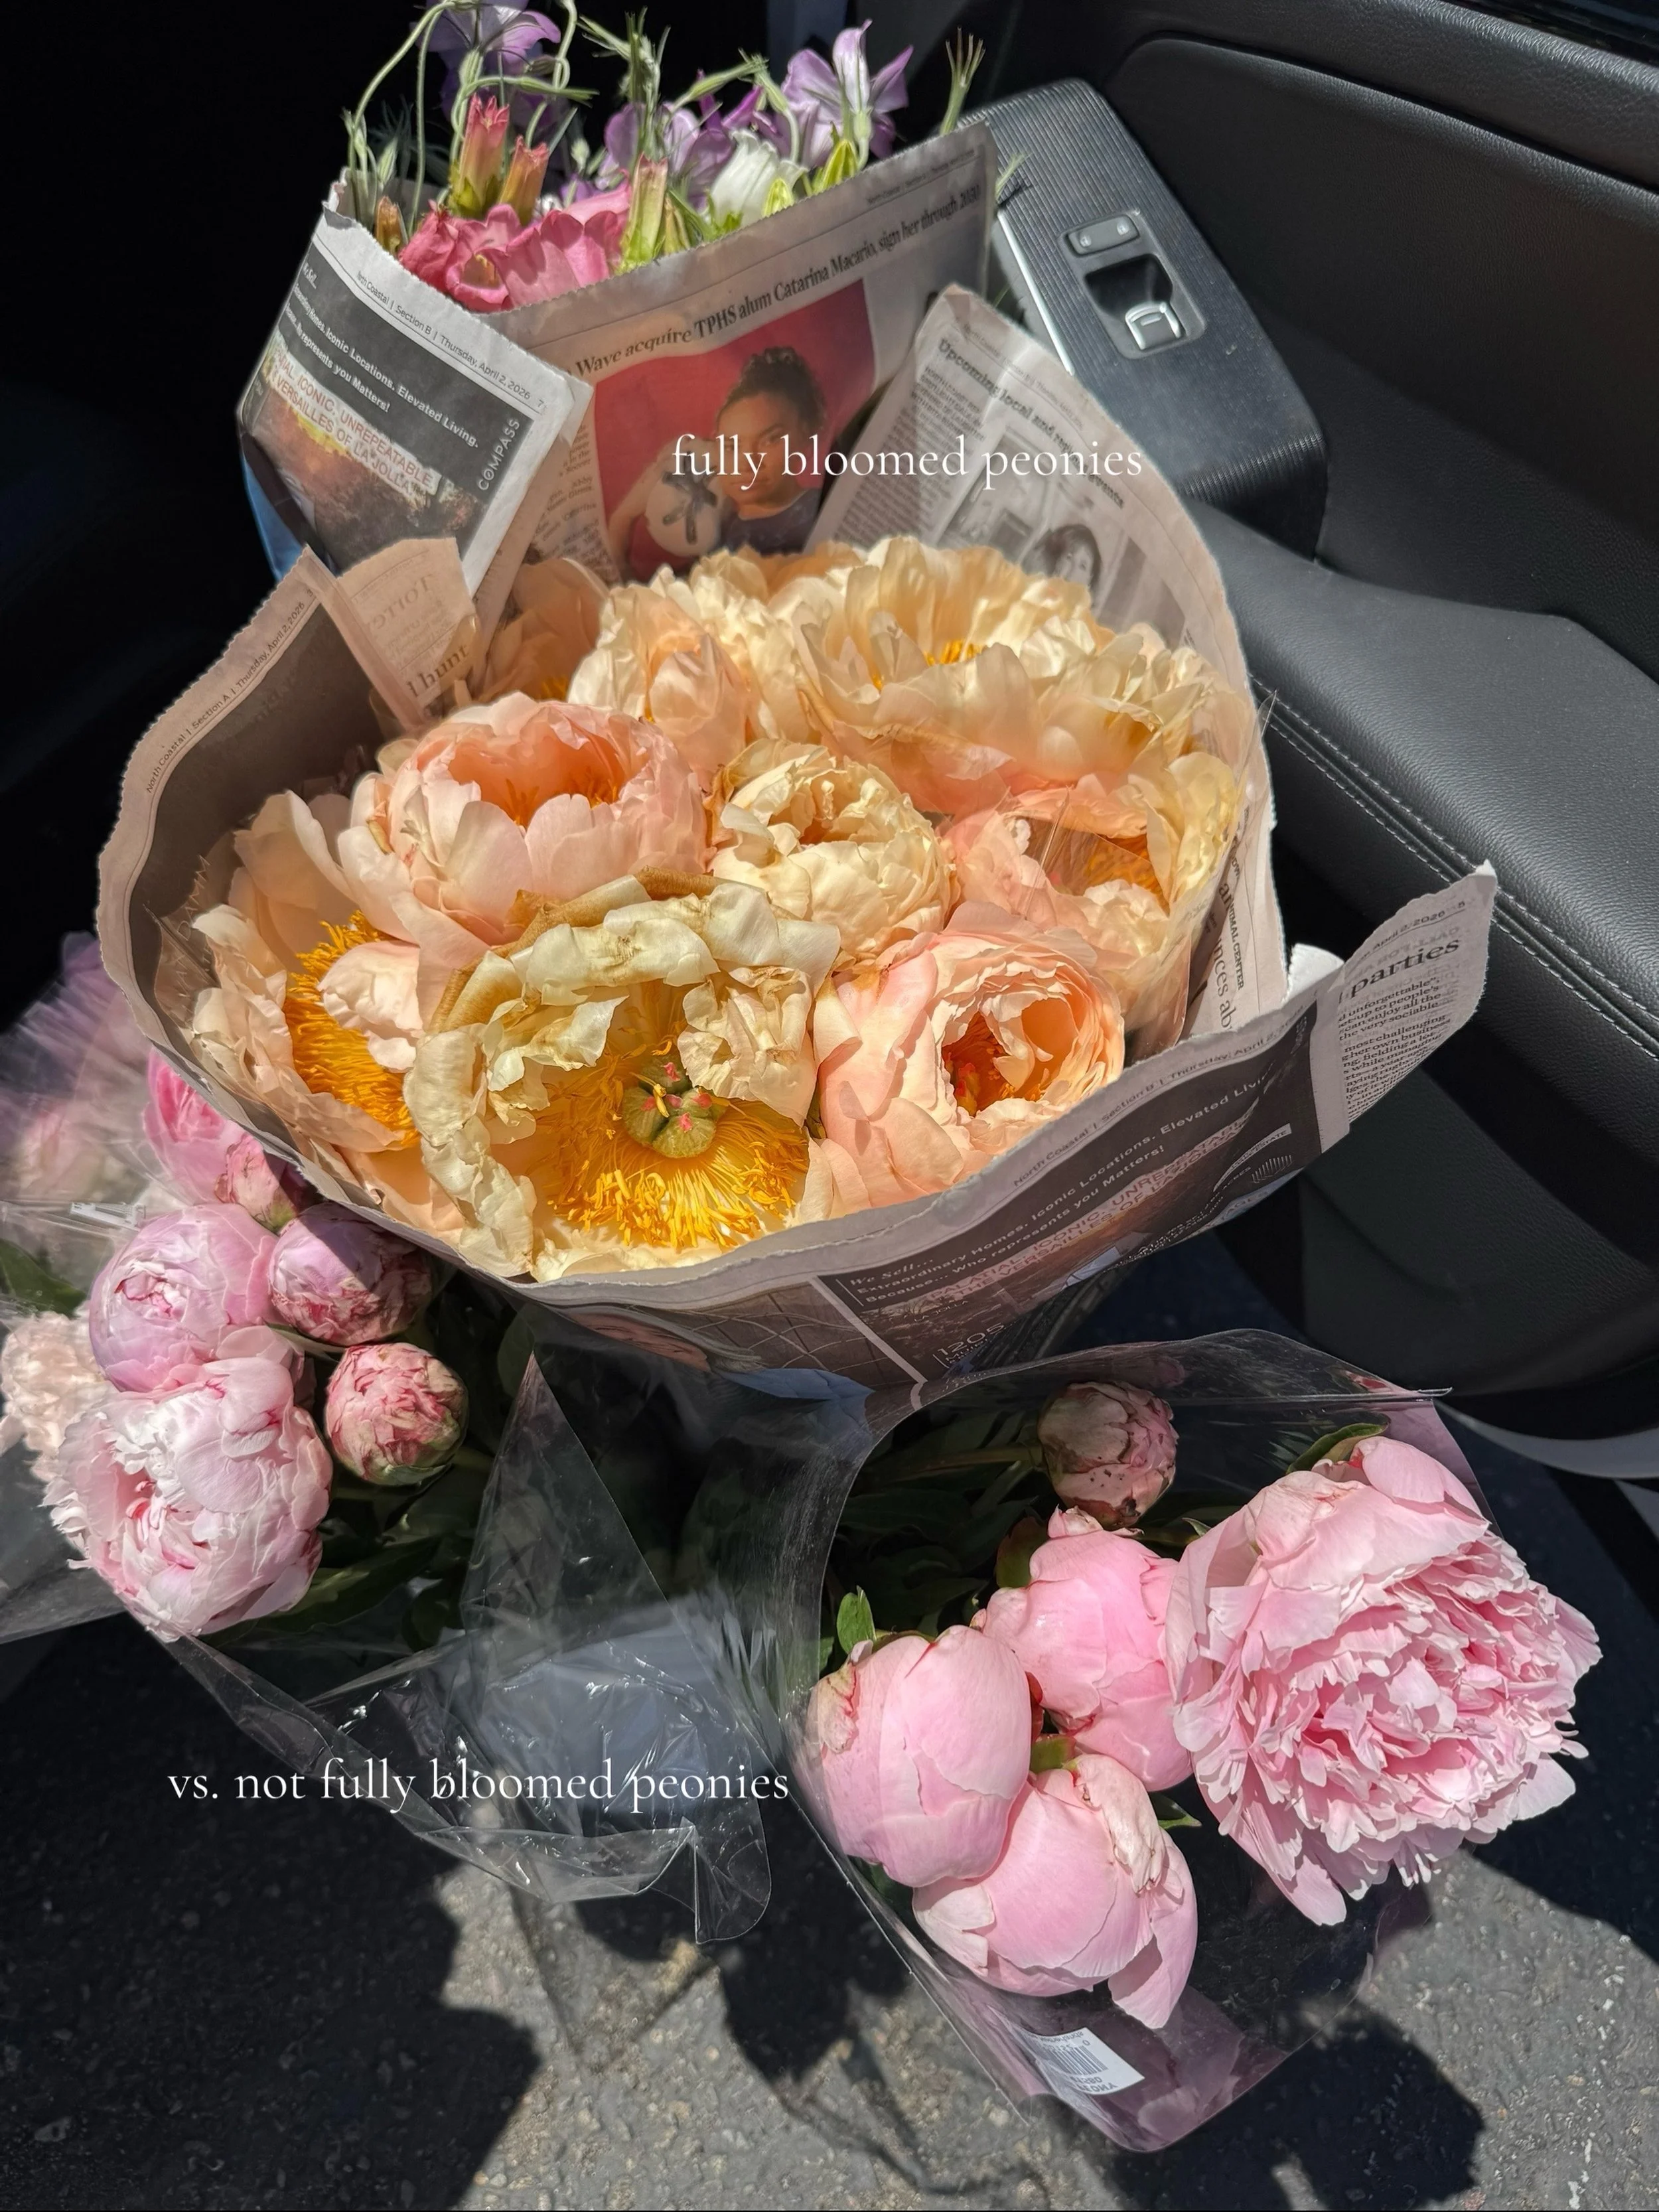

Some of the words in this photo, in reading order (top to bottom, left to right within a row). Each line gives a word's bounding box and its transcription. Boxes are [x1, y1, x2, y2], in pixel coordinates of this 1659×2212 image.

[366, 281, 390, 305] Coastal
[396, 305, 424, 331] Section
[425, 325, 433, 334] B
[440, 335, 478, 367] Thursday,
[479, 362, 500, 379] April
[498, 375, 506, 386] 2,
[508, 381, 532, 400] 2026
[575, 350, 622, 377] Wave
[625, 328, 691, 358] acquire
[694, 305, 737, 339] TPHS
[739, 295, 772, 319] alum
[773, 265, 830, 301] Catarina
[298, 375, 335, 415] ICONIC.
[301, 332, 333, 368] represents
[332, 364, 352, 382] you
[352, 378, 391, 413] Matters!
[325, 327, 349, 354] Iconic
[350, 347, 396, 392] Locations.
[397, 384, 443, 422] Elevated
[443, 416, 478, 449] Living.
[938, 338, 1001, 398] Upcoming
[998, 388, 1034, 419] local
[1031, 415, 1055, 439] and
[277, 374, 334, 433] VERSAILLES
[336, 429, 353, 446] OF
[354, 441, 369, 463] LA
[477, 417, 521, 491] COMPASS
[417, 644, 470, 689] hunt
[146, 766, 162, 793] North
[159, 734, 187, 767] Coastal
[192, 700, 223, 729] Section
[222, 694, 230, 703] A
[236, 650, 271, 688] Thursday,
[267, 631, 283, 653] April
[282, 624, 291, 634] 2,
[287, 601, 305, 625] 2026
[306, 589, 315, 598] 3
[1372, 930, 1398, 950] April
[1412, 911, 1445, 927] 2026
[1233, 942, 1244, 990] CENTER
[1351, 939, 1459, 998] parties
[1219, 999, 1237, 1031] ab
[1339, 1031, 1358, 1041] the
[1360, 1019, 1388, 1033] very
[1388, 1001, 1439, 1021] sociable
[1368, 1006, 1402, 1023] enjoy
[1403, 998, 1418, 1010] all
[1421, 993, 1441, 1003] the
[1389, 986, 1439, 1008] people's
[1344, 1039, 1375, 1053] most
[1376, 1014, 1447, 1042] challenging
[1349, 1046, 1372, 1059] her
[1372, 1039, 1398, 1050] own
[1363, 1043, 1409, 1061] fielding
[1351, 1057, 1384, 1072] while
[1013, 1159, 1045, 1187] North
[1046, 1128, 1090, 1160] Coastal
[1101, 1090, 1144, 1122] Section
[1234, 1039, 1263, 1054] April
[857, 1254, 967, 1294] Extraordinary
[971, 1223, 1029, 1255] Homes.
[1031, 1188, 1076, 1221] Iconic
[1079, 1136, 1156, 1188] Locations.
[1160, 1095, 1229, 1135] Elevated
[866, 1275, 949, 1302] Because...
[952, 1257, 986, 1274] Who
[991, 1209, 1070, 1257] represents
[1074, 1188, 1099, 1209] you
[1102, 1145, 1165, 1187] Matters!
[960, 1277, 994, 1296] THE
[999, 1213, 1113, 1276] VERSAILLES
[1119, 1192, 1143, 1211] OF
[850, 1277, 875, 1286] We
[881, 1259, 934, 1280] Sell...
[937, 1322, 1005, 1355] 1205
